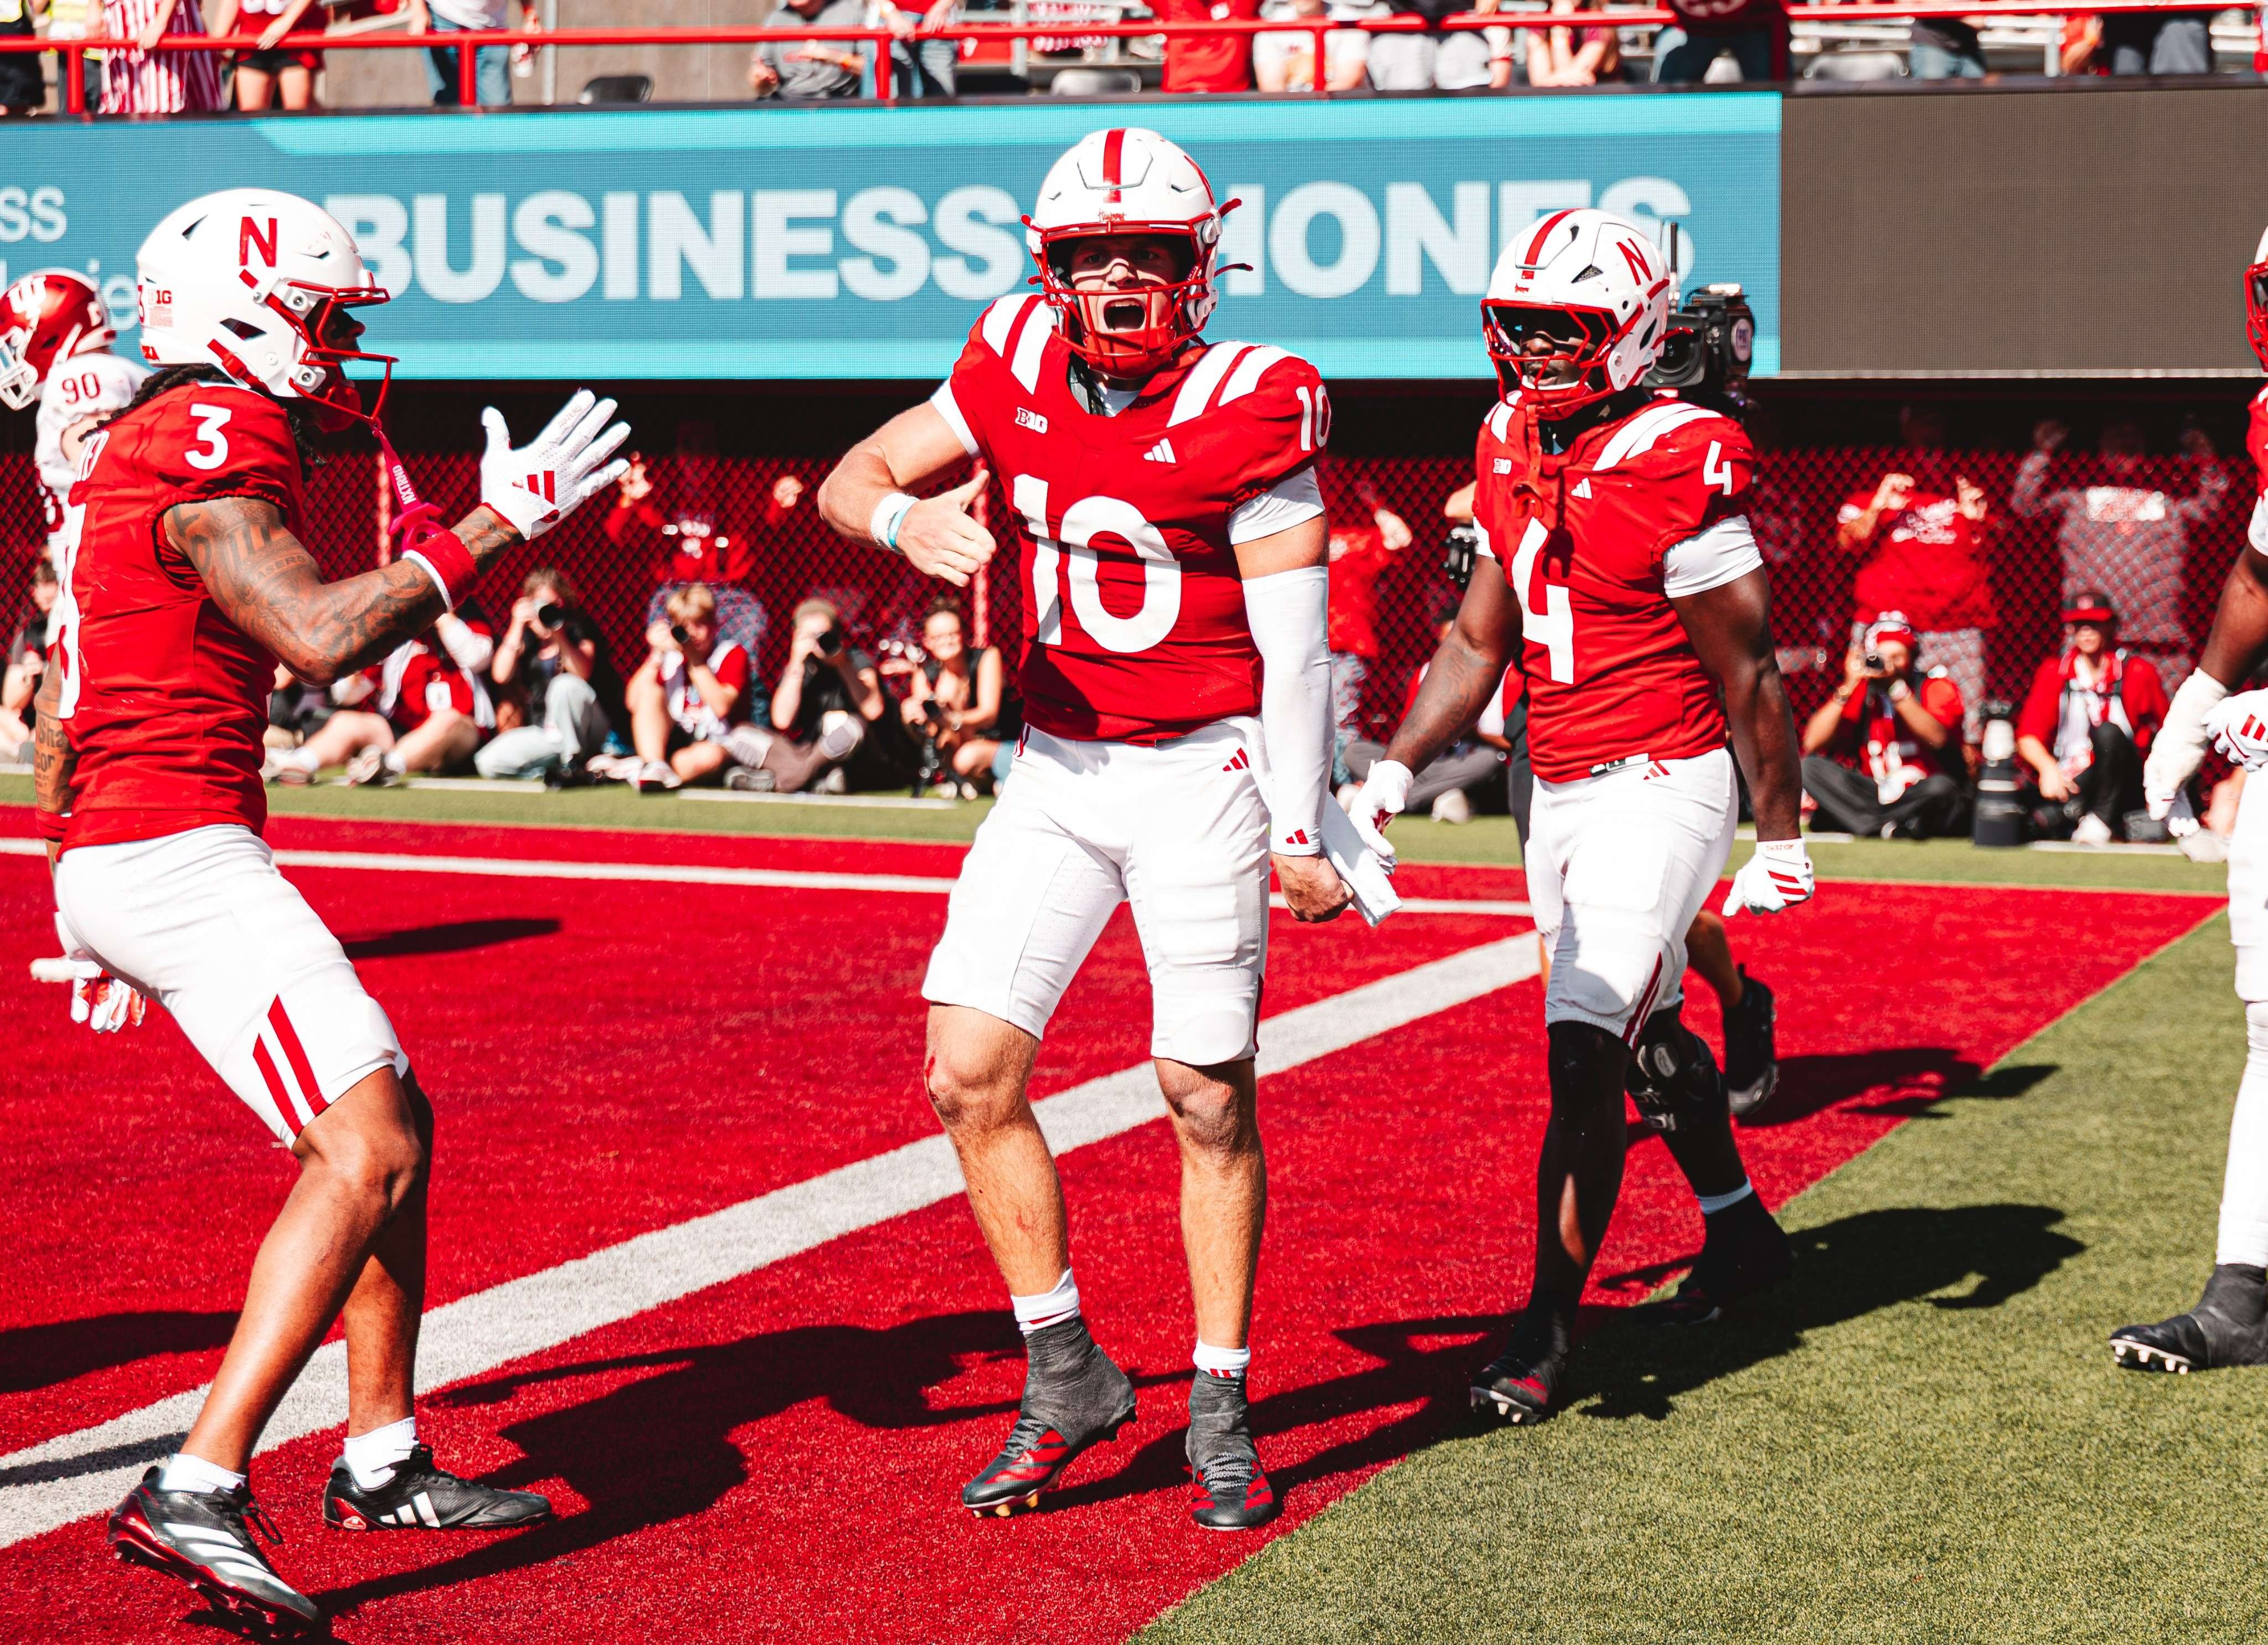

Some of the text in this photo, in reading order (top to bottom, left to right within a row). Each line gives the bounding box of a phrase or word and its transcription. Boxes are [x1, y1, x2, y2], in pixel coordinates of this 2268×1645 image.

[239, 216, 277, 267] N
[324, 186, 1025, 303] BUSINESS
[1616, 238, 1652, 286] N
[62, 373, 100, 404] 90
[1296, 384, 1331, 451] 10
[185, 404, 231, 470] 3
[392, 464, 417, 505] NXTRND
[1703, 441, 1732, 495] 4
[1013, 474, 1181, 653] 10
[1511, 517, 1574, 685] 4
